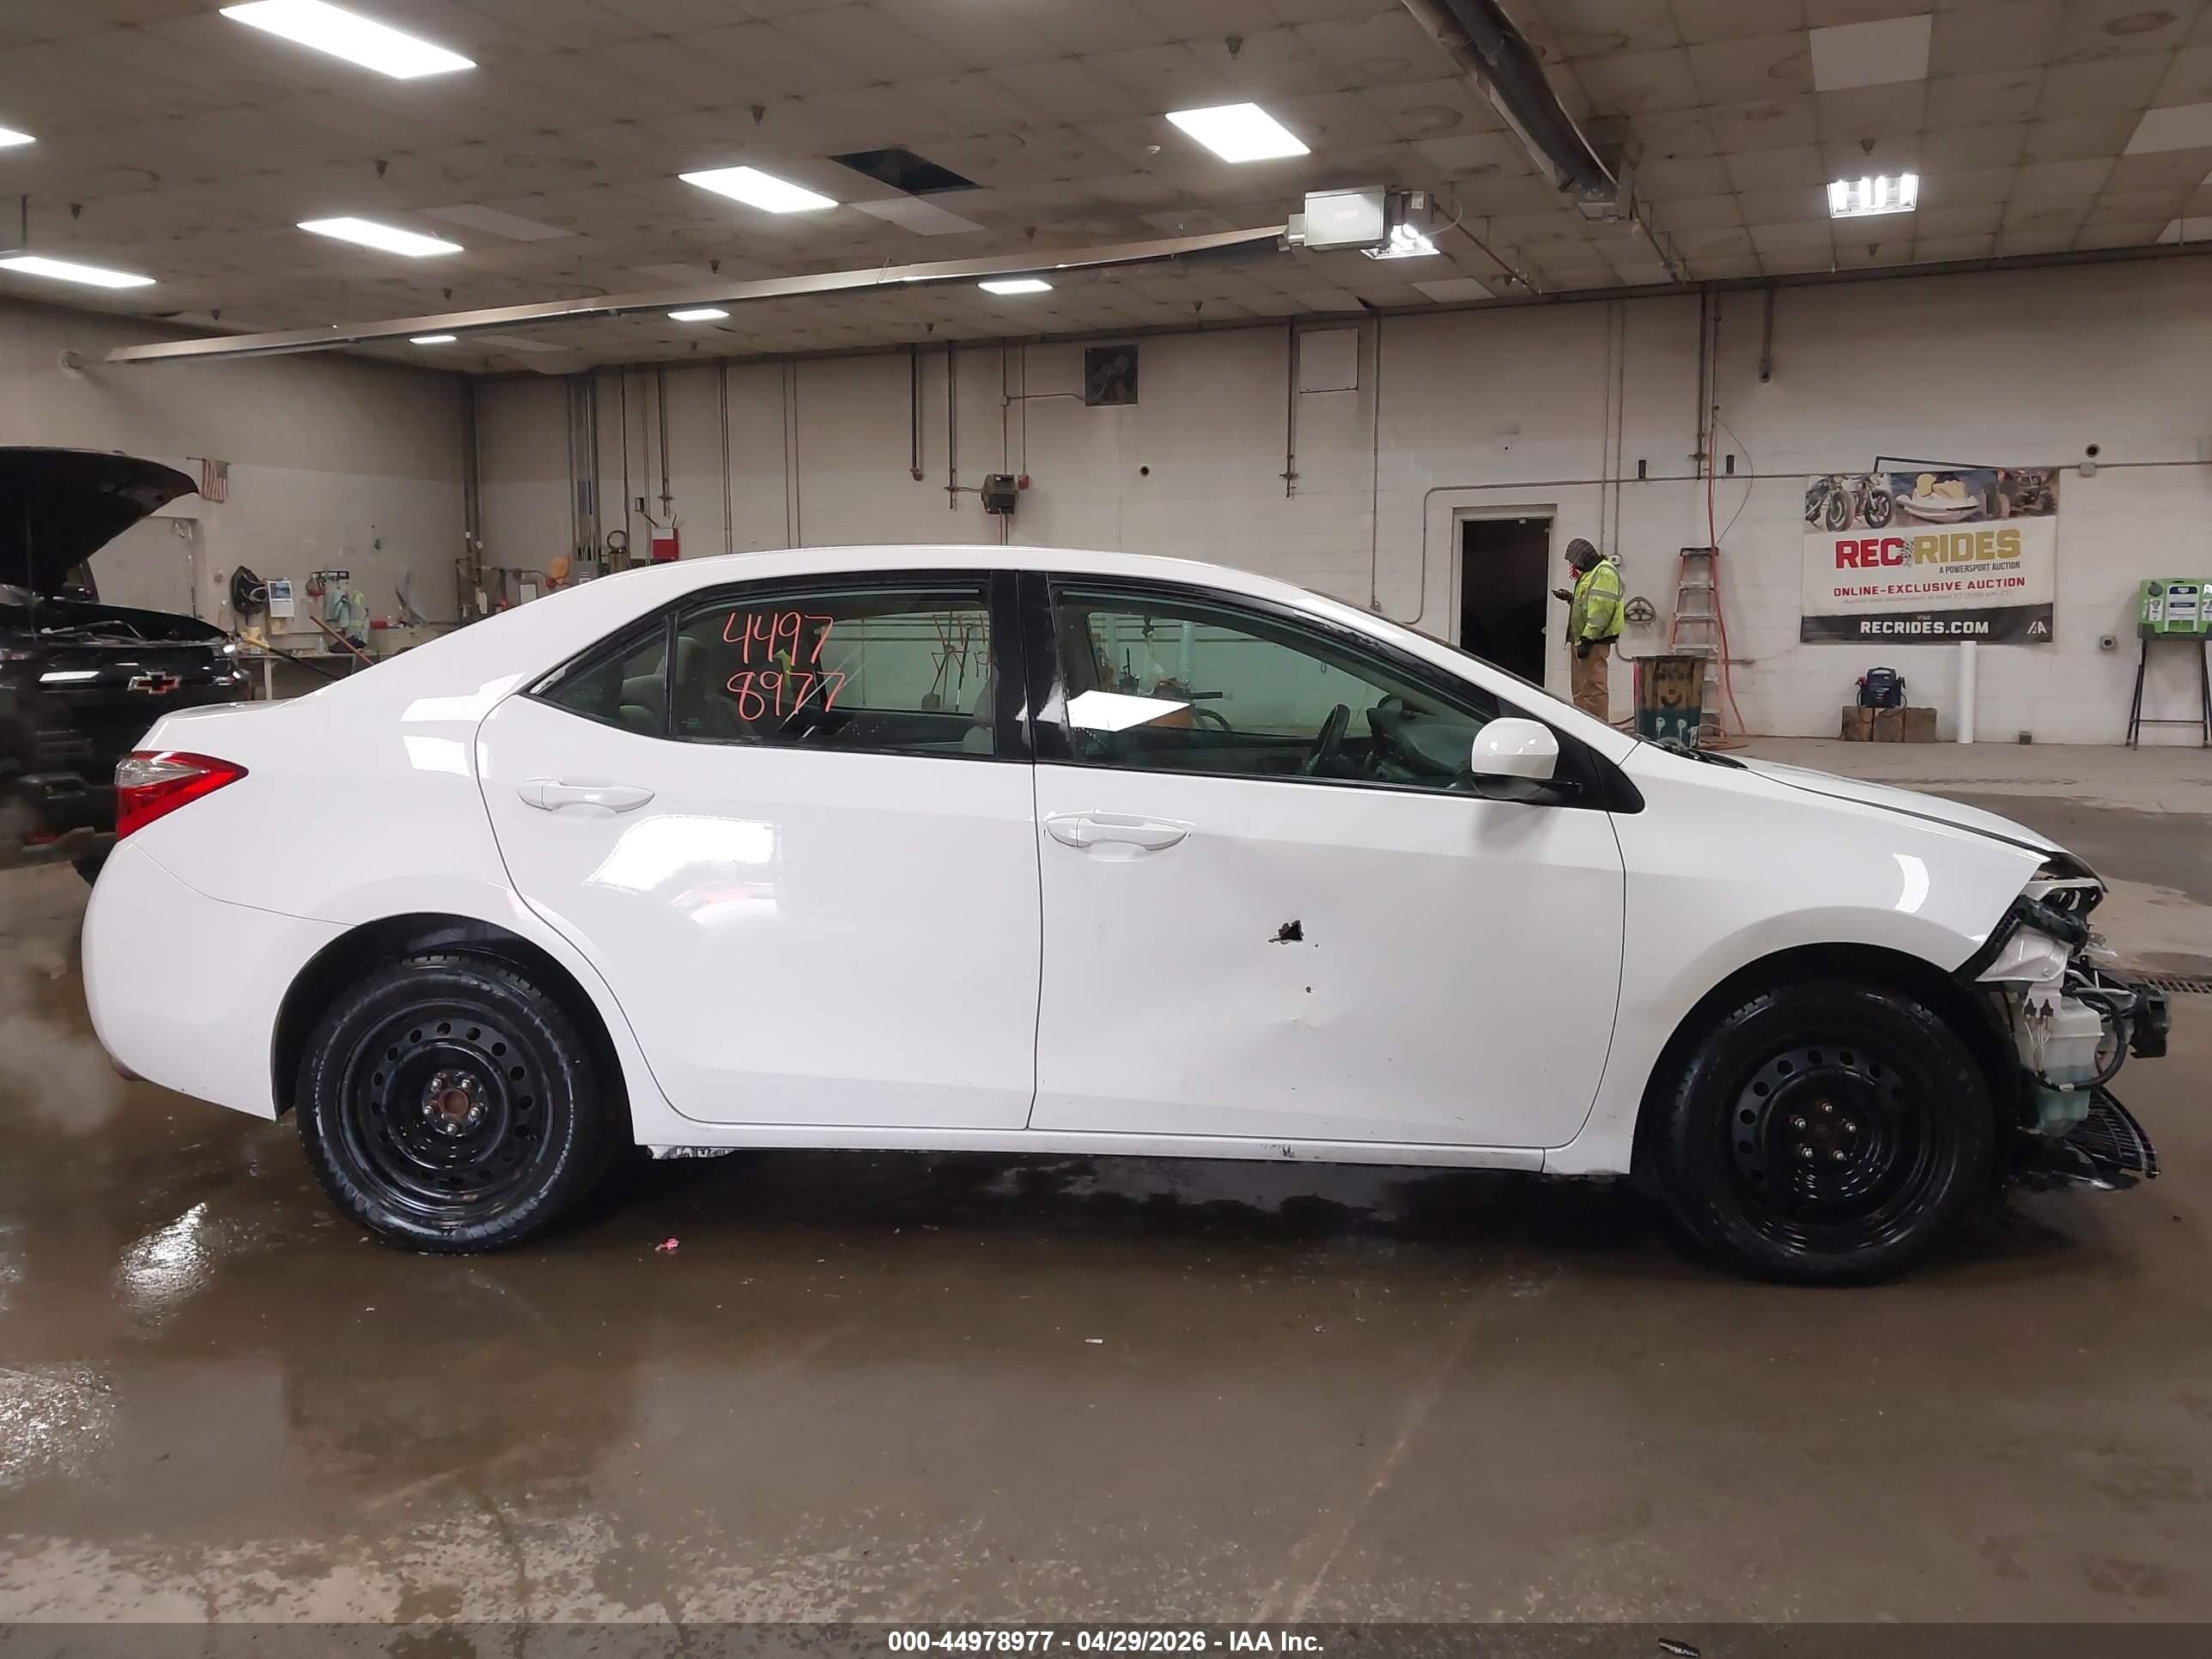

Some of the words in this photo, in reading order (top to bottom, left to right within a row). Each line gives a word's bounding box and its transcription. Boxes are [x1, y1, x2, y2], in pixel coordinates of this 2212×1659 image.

[1836, 538, 1904, 568] REC
[1914, 529, 2021, 564] RIDES
[1945, 563, 1990, 574] POWERSPORT
[1992, 561, 2021, 571] AUCTION
[1833, 580, 1962, 597] ONLINE-EXCLUSIVE
[1966, 577, 2025, 589] AUCTION
[723, 611, 834, 666] 4497
[1860, 621, 1989, 634] RECRIDES.COM
[726, 670, 846, 720] 8977
